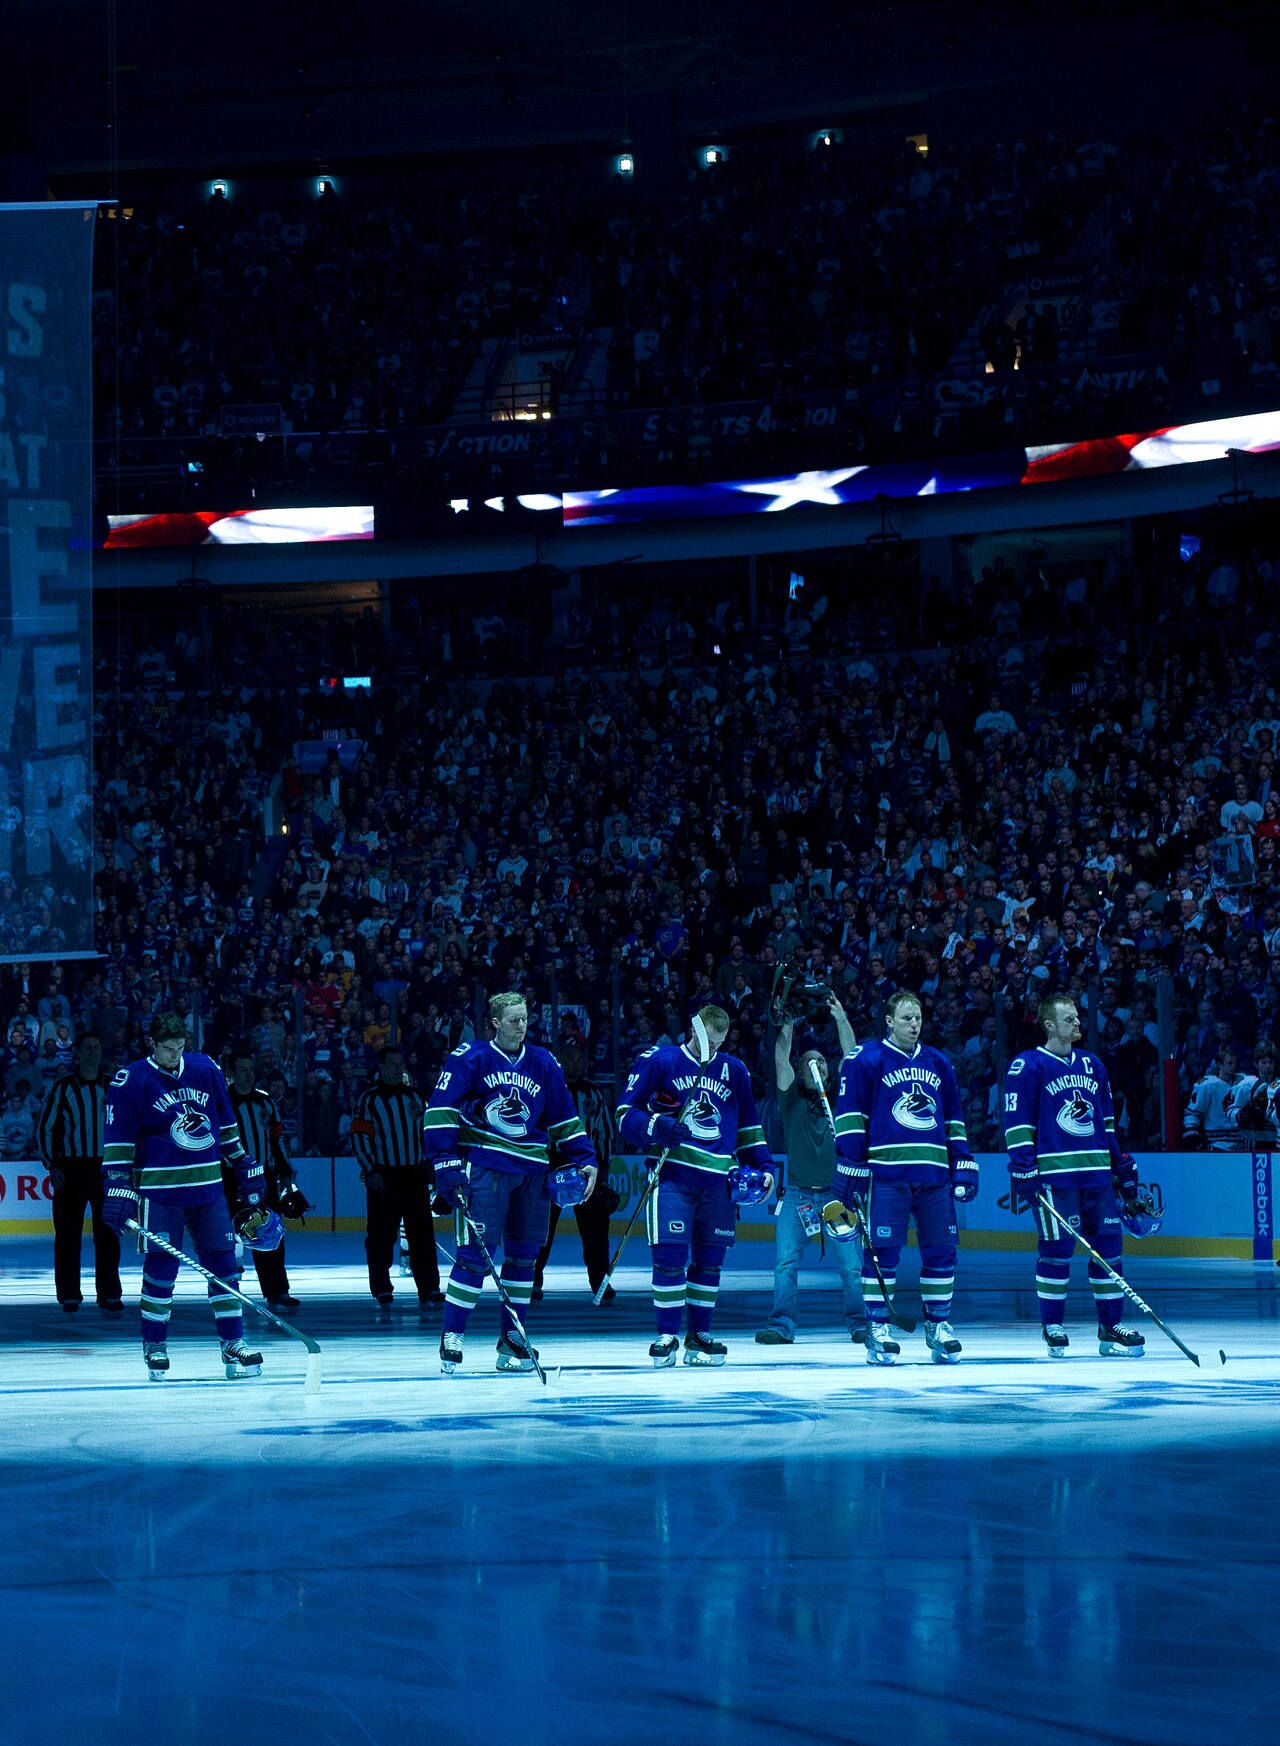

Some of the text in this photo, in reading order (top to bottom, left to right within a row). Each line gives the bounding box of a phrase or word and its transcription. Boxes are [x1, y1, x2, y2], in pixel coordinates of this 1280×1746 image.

[720, 1062, 730, 1081] A
[1081, 1056, 1094, 1074] C
[483, 1071, 541, 1098] VANCOUVER
[881, 1067, 942, 1091] VANCOUVER
[1045, 1074, 1099, 1096] VANCOUVER
[152, 1087, 209, 1113] VANCOUVER
[1255, 1153, 1270, 1237] Reebok
